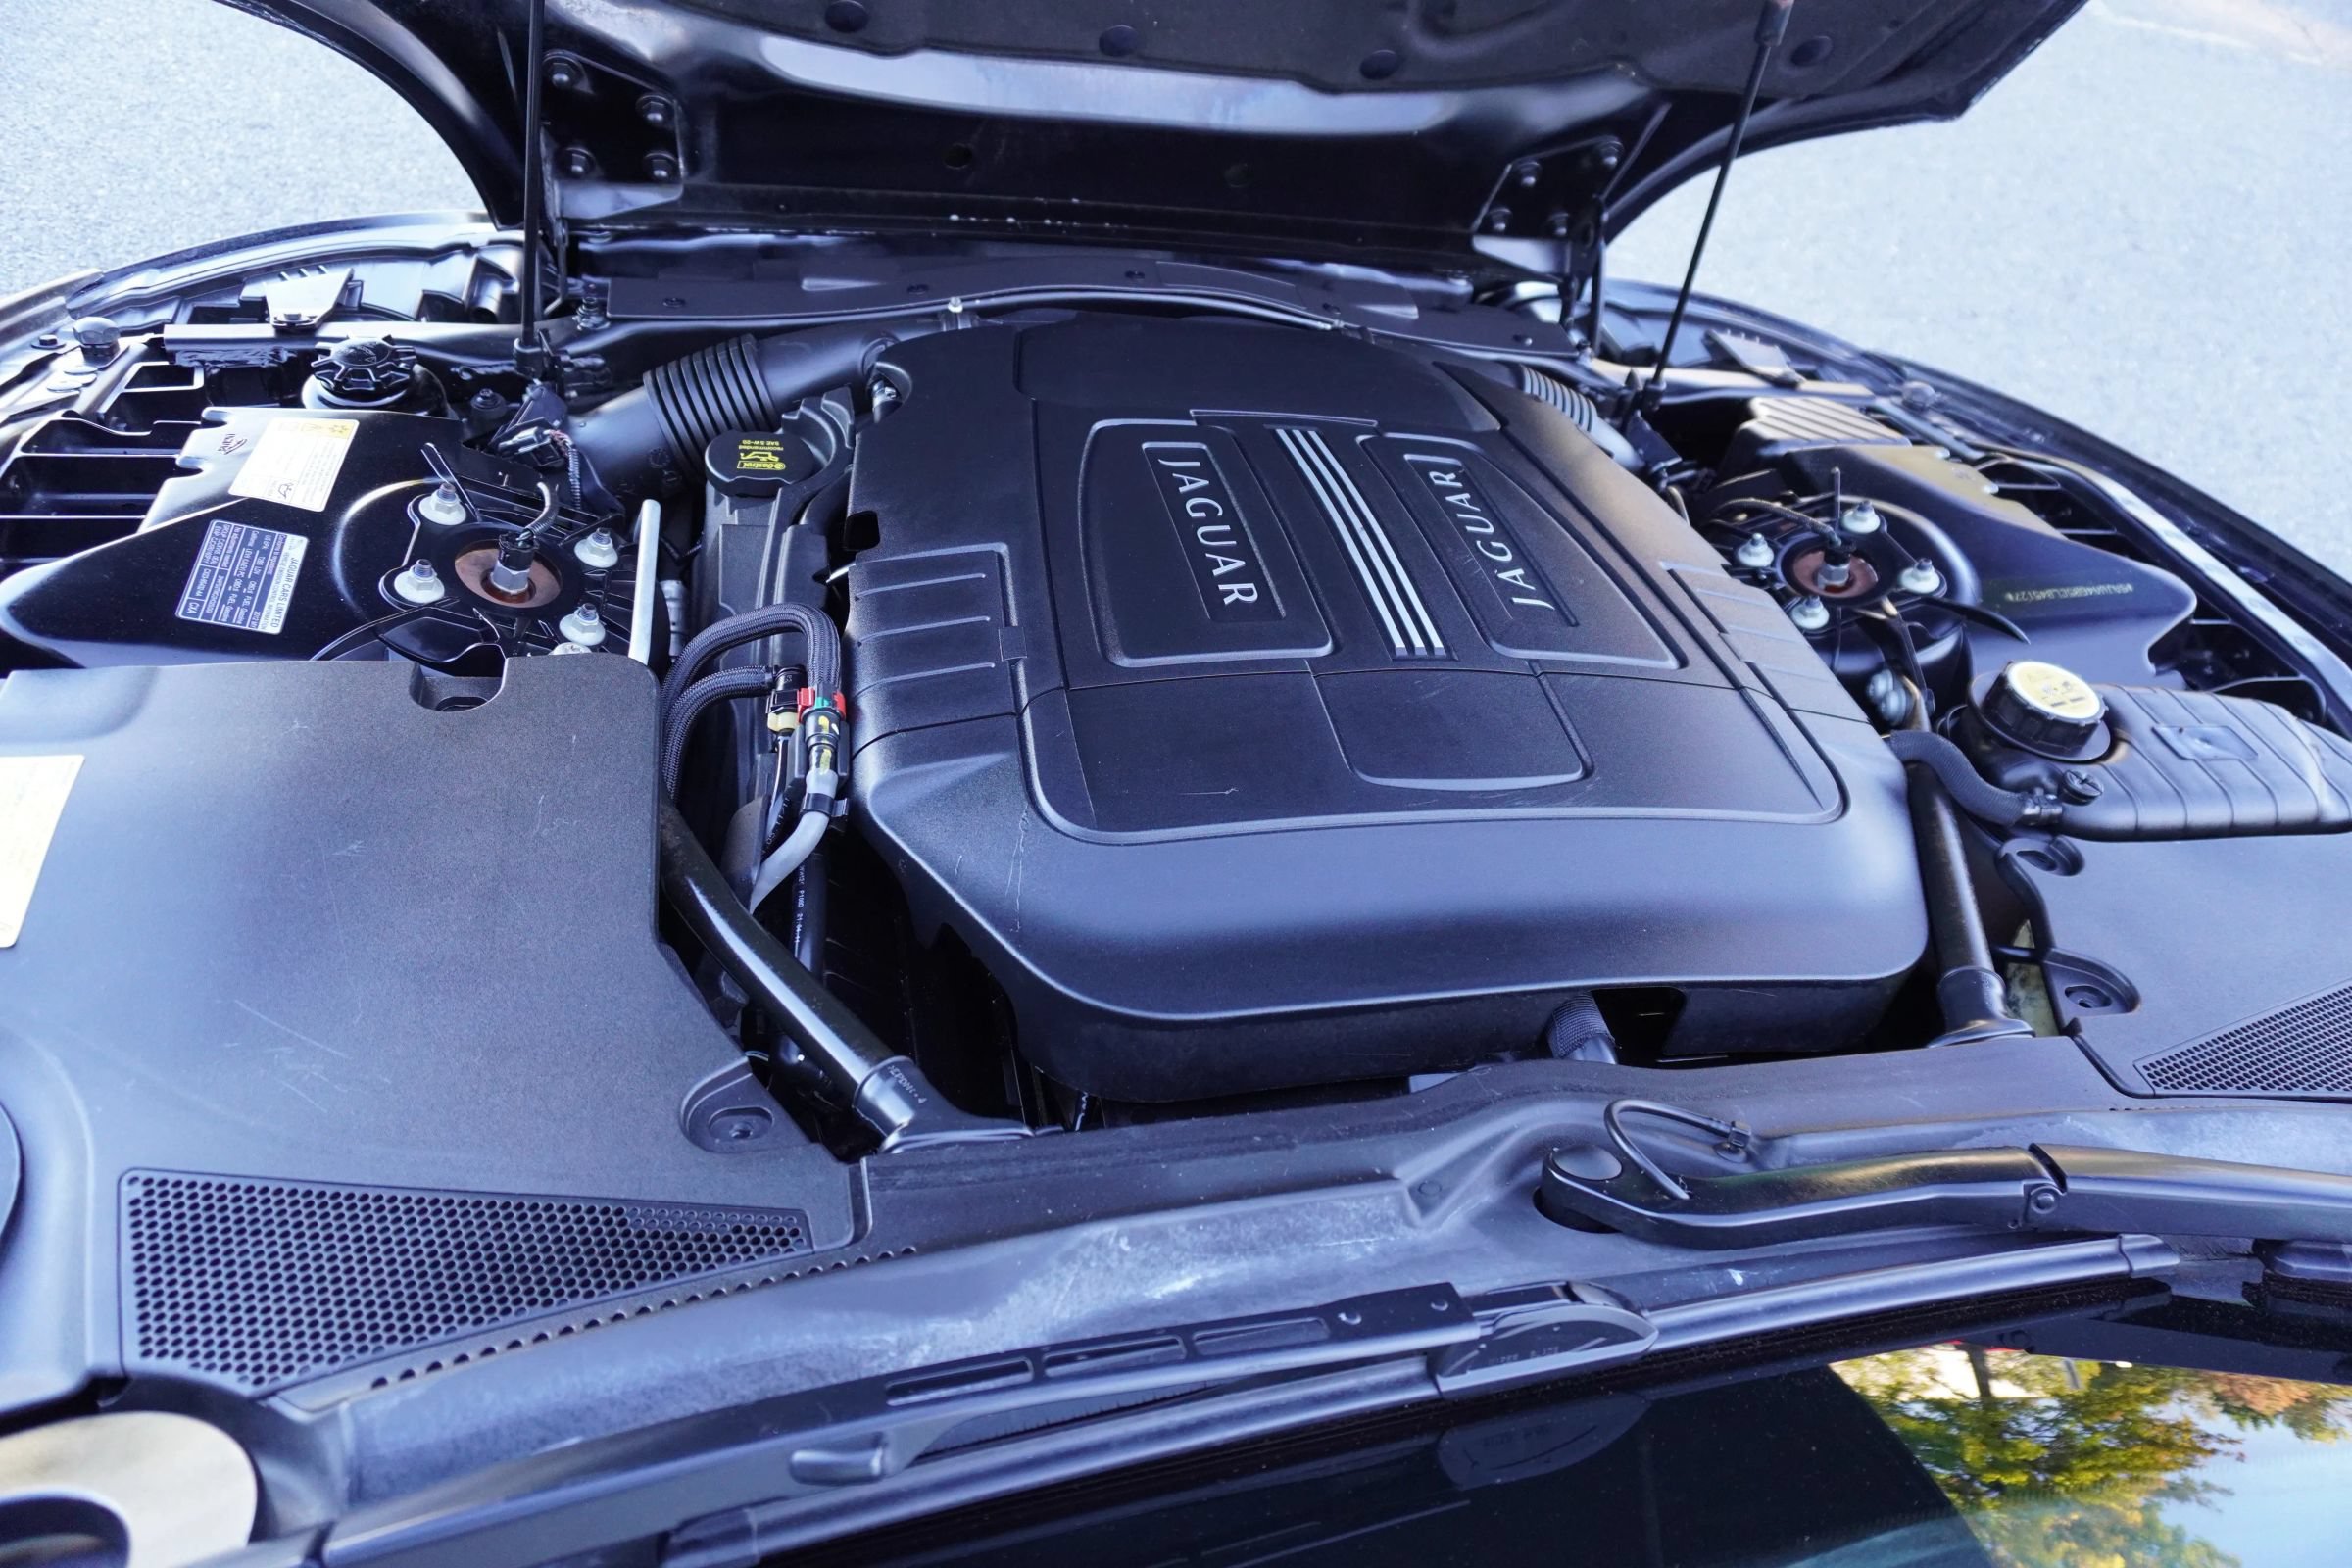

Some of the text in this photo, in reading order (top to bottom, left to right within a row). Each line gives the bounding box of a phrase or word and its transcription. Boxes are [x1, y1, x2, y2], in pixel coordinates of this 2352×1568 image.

[1157, 457, 1259, 607] JAGUAR
[1428, 468, 1556, 612] JAGUAR
[283, 557, 299, 583] JAGUAR
[277, 582, 291, 602] CARS
[185, 601, 200, 614] CXA
[270, 602, 285, 628] LIMITED
